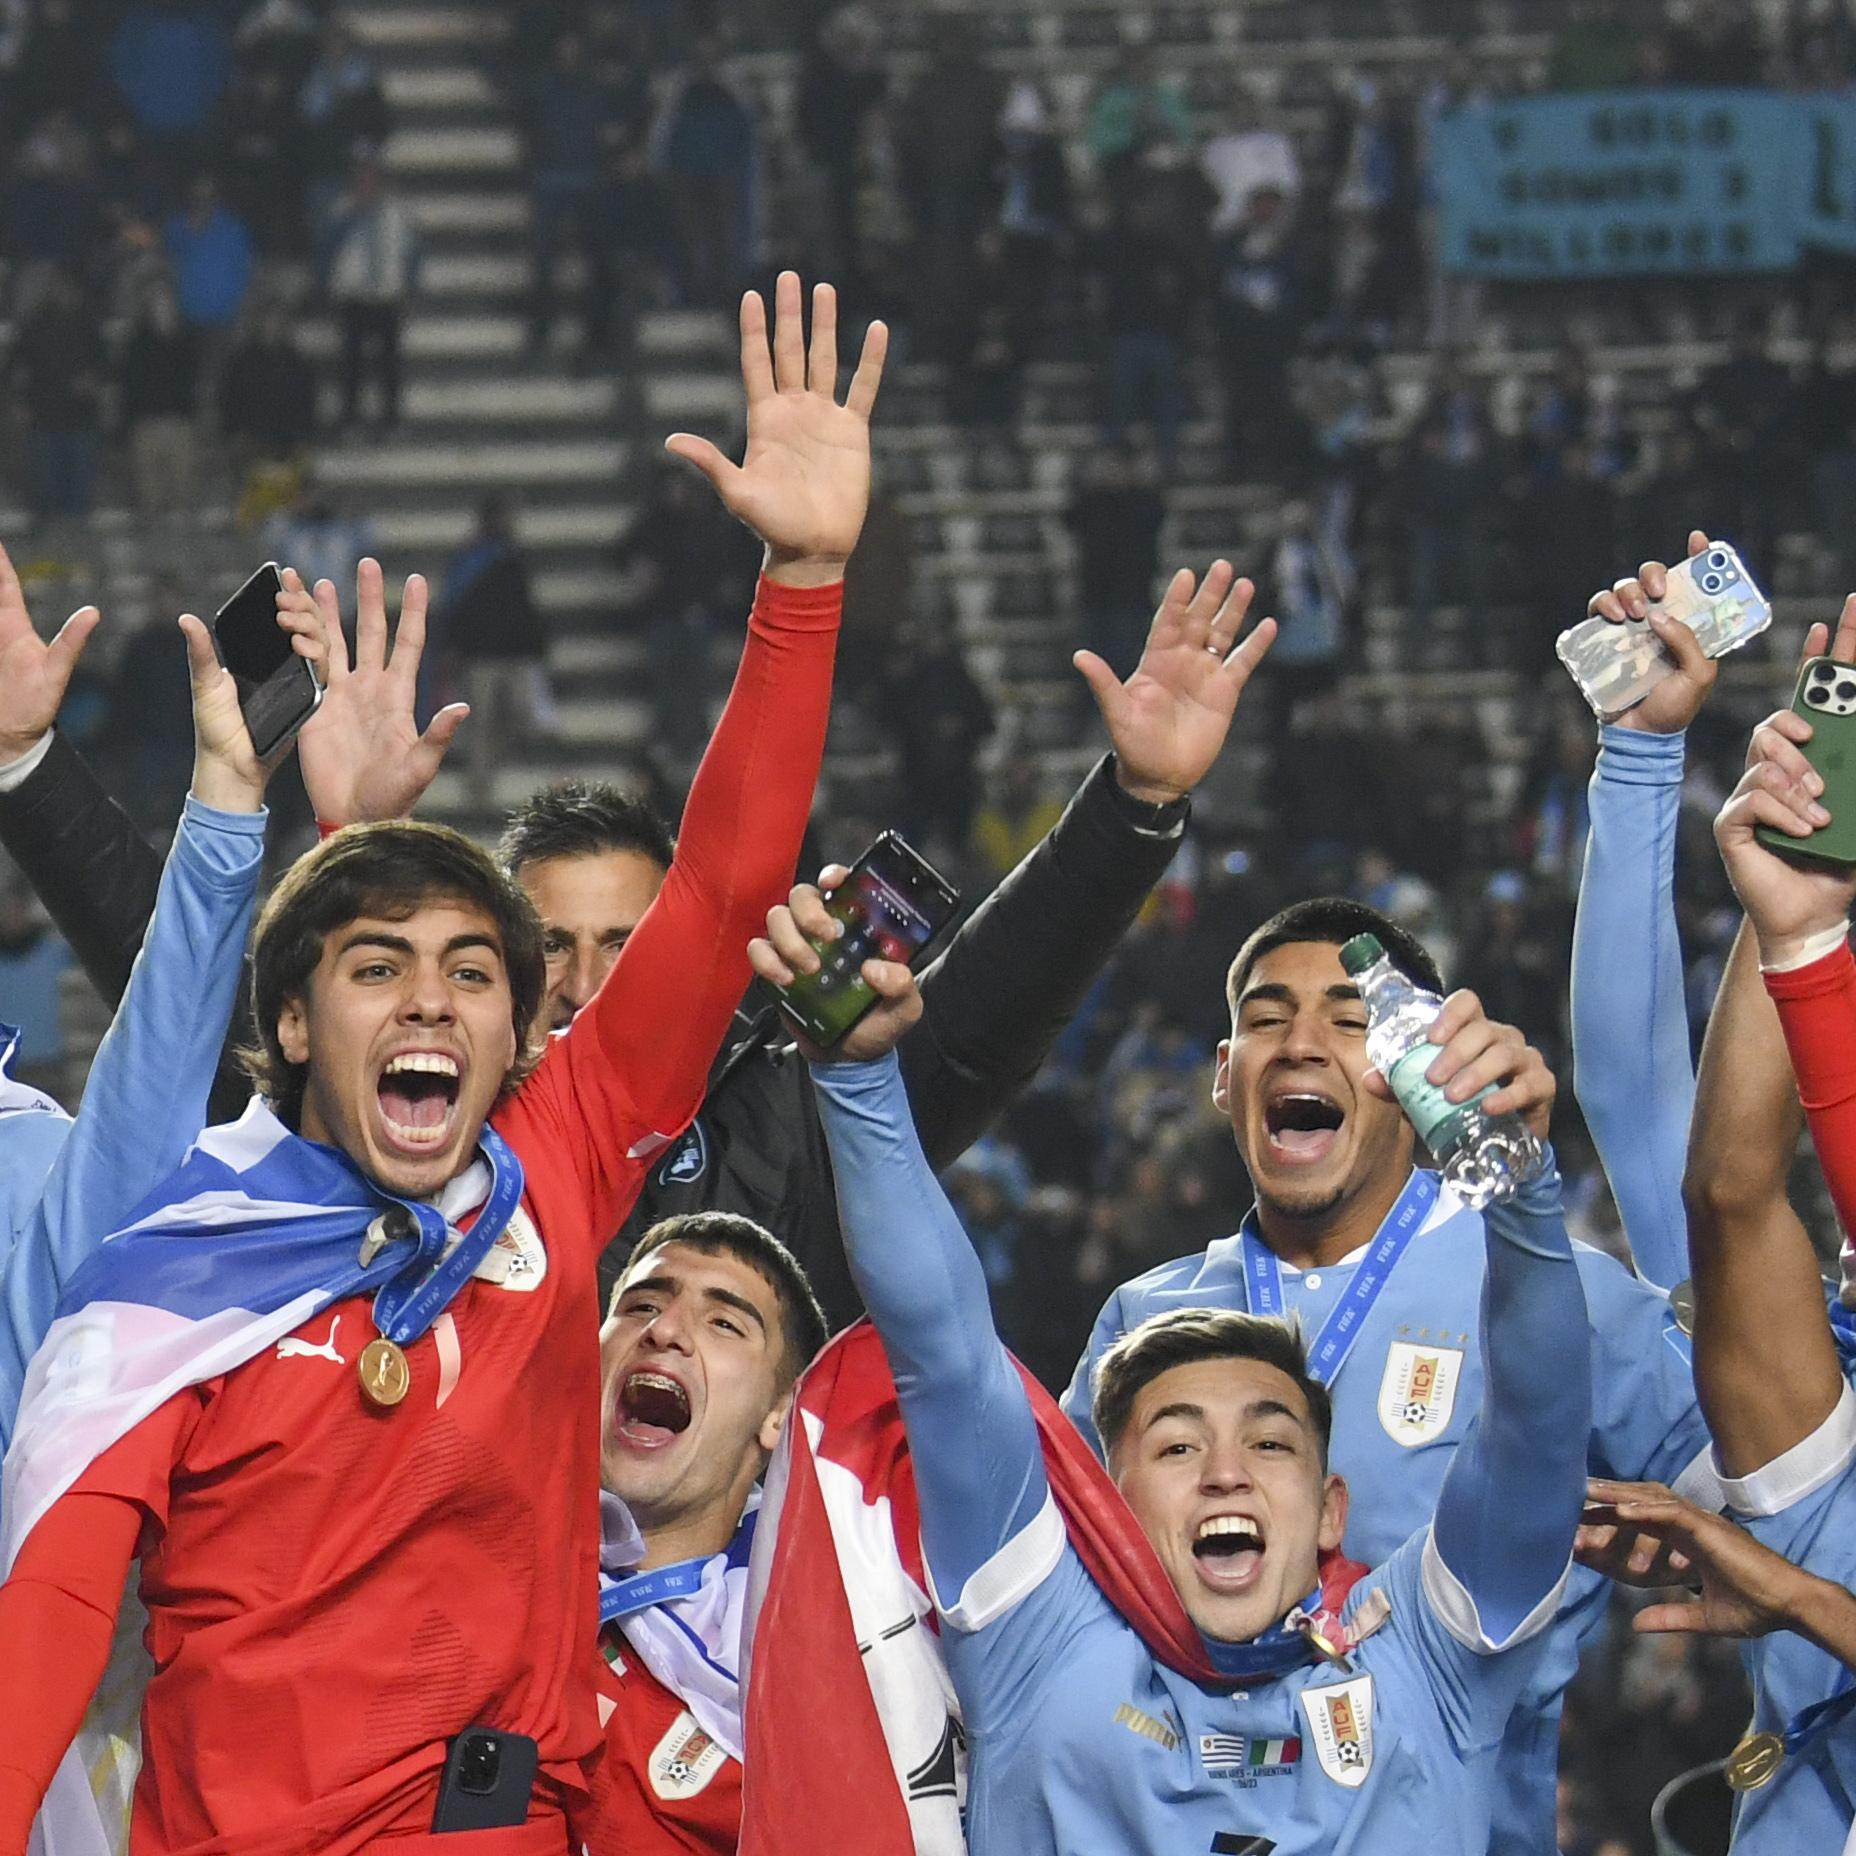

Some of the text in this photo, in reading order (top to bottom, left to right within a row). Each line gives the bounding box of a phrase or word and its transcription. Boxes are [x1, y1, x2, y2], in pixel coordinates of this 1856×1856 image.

[1398, 1205, 1417, 1229] FIFA
[1377, 1239, 1397, 1264] FIFA
[1357, 1273, 1376, 1299] FIFA
[418, 1288, 442, 1315] FIFA
[1338, 1307, 1356, 1333] FIFA
[1411, 1364, 1431, 1398] AUF
[1114, 1703, 1176, 1751] PUMA
[1333, 1701, 1352, 1739] AUF
